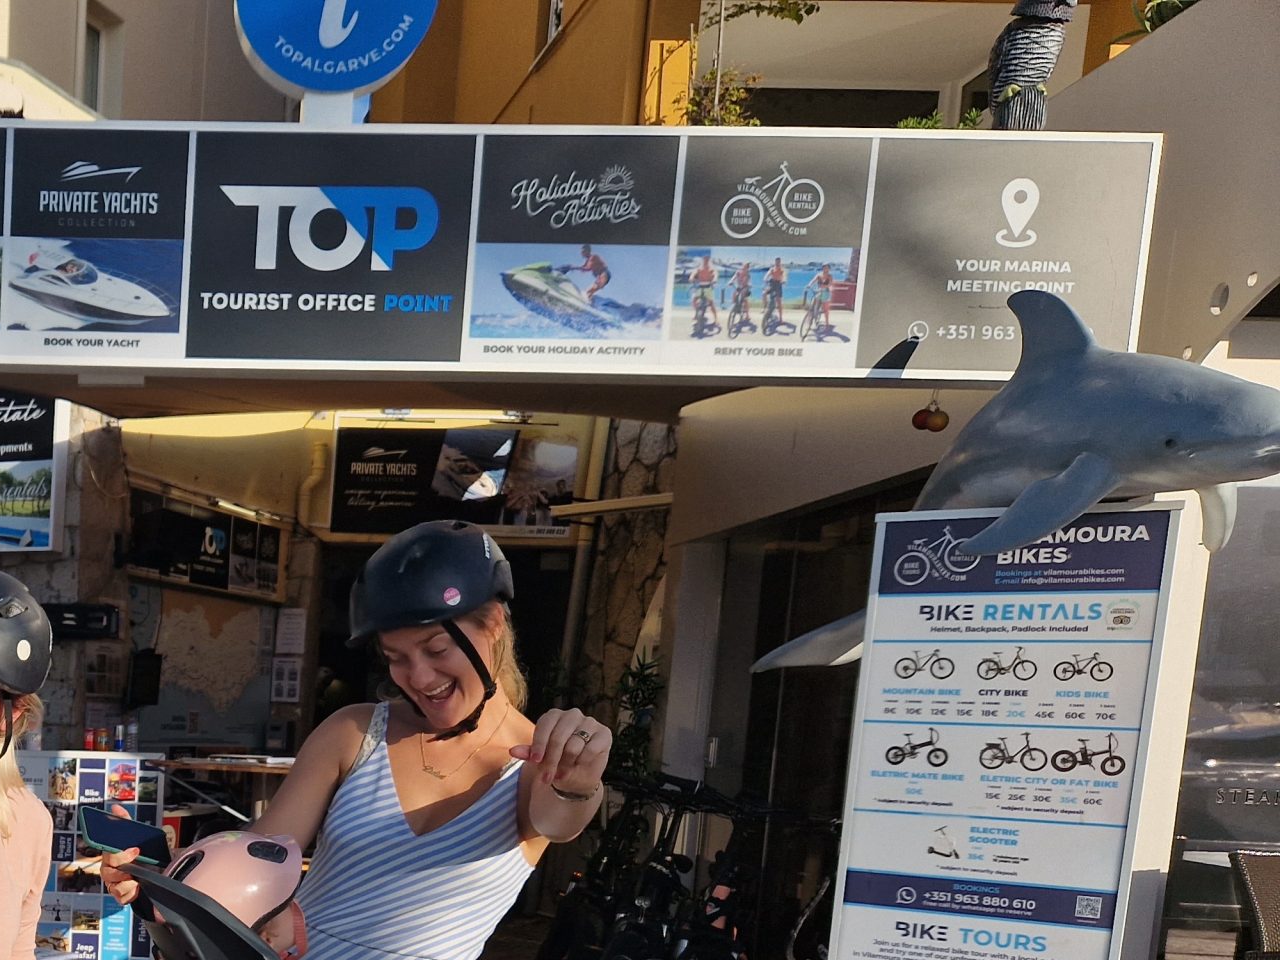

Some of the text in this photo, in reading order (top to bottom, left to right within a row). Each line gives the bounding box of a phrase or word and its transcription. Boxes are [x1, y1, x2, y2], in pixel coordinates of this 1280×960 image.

[273, 14, 415, 74] TOPALGARVE.COM
[511, 170, 598, 216] Holiday
[793, 192, 813, 201] BIKE
[39, 190, 159, 215] PRIVATE YACHTS
[788, 202, 817, 210] RENTALS
[549, 190, 642, 229] Activities
[733, 208, 752, 217] BIKE
[736, 184, 808, 236] VILAMOURABIKES.COM
[730, 217, 753, 225] TOURS
[220, 185, 439, 272] TOP
[955, 259, 1072, 273] YOUR MARINA
[946, 279, 1076, 294] MEETING POINT
[200, 292, 454, 313] TOURIST OFFICE POINT
[936, 324, 1015, 341] +351 963
[43, 337, 141, 348] BOOK YOUR YACHT
[483, 344, 646, 356] BOOK YOUR HOLIDAY ACTIVITY
[714, 347, 803, 357] RENT YOUR BIKE
[350, 462, 417, 476] PRIVATE YACHTS
[996, 546, 1068, 565] BIKES
[995, 567, 1125, 578] Bookings vilamourabikes.com
[1020, 575, 1125, 586] info@vilamourabikes.com
[919, 602, 1102, 622] BIKE RENTALS
[930, 624, 1089, 635] Helmet, Backpack, Padlock Included
[881, 687, 962, 697] MOUNTAIN BIKE
[978, 688, 1029, 698] CITY BIKE
[1055, 689, 1110, 700] KIDS BIKE
[1035, 711, 1116, 720] 45€ 60€ 70€
[979, 774, 1119, 788] ELETRIC CITY OR FAT BIKE
[84, 788, 100, 797] Bike
[1032, 795, 1103, 806] 30€ 60€
[970, 826, 1020, 837] ELECTRIC
[968, 836, 1018, 846] SCOOTER
[953, 883, 1000, 894] BOOKINGS
[923, 891, 1036, 910] +351 963 880 610
[895, 921, 1047, 953] BIKE TOURS
[76, 943, 94, 954] Jeep
[873, 938, 890, 947] Join
[920, 944, 950, 953] relaxed
[951, 947, 970, 956] bike
[970, 950, 988, 958] tour
[990, 952, 1009, 960] with
[74, 951, 96, 960] Safari
